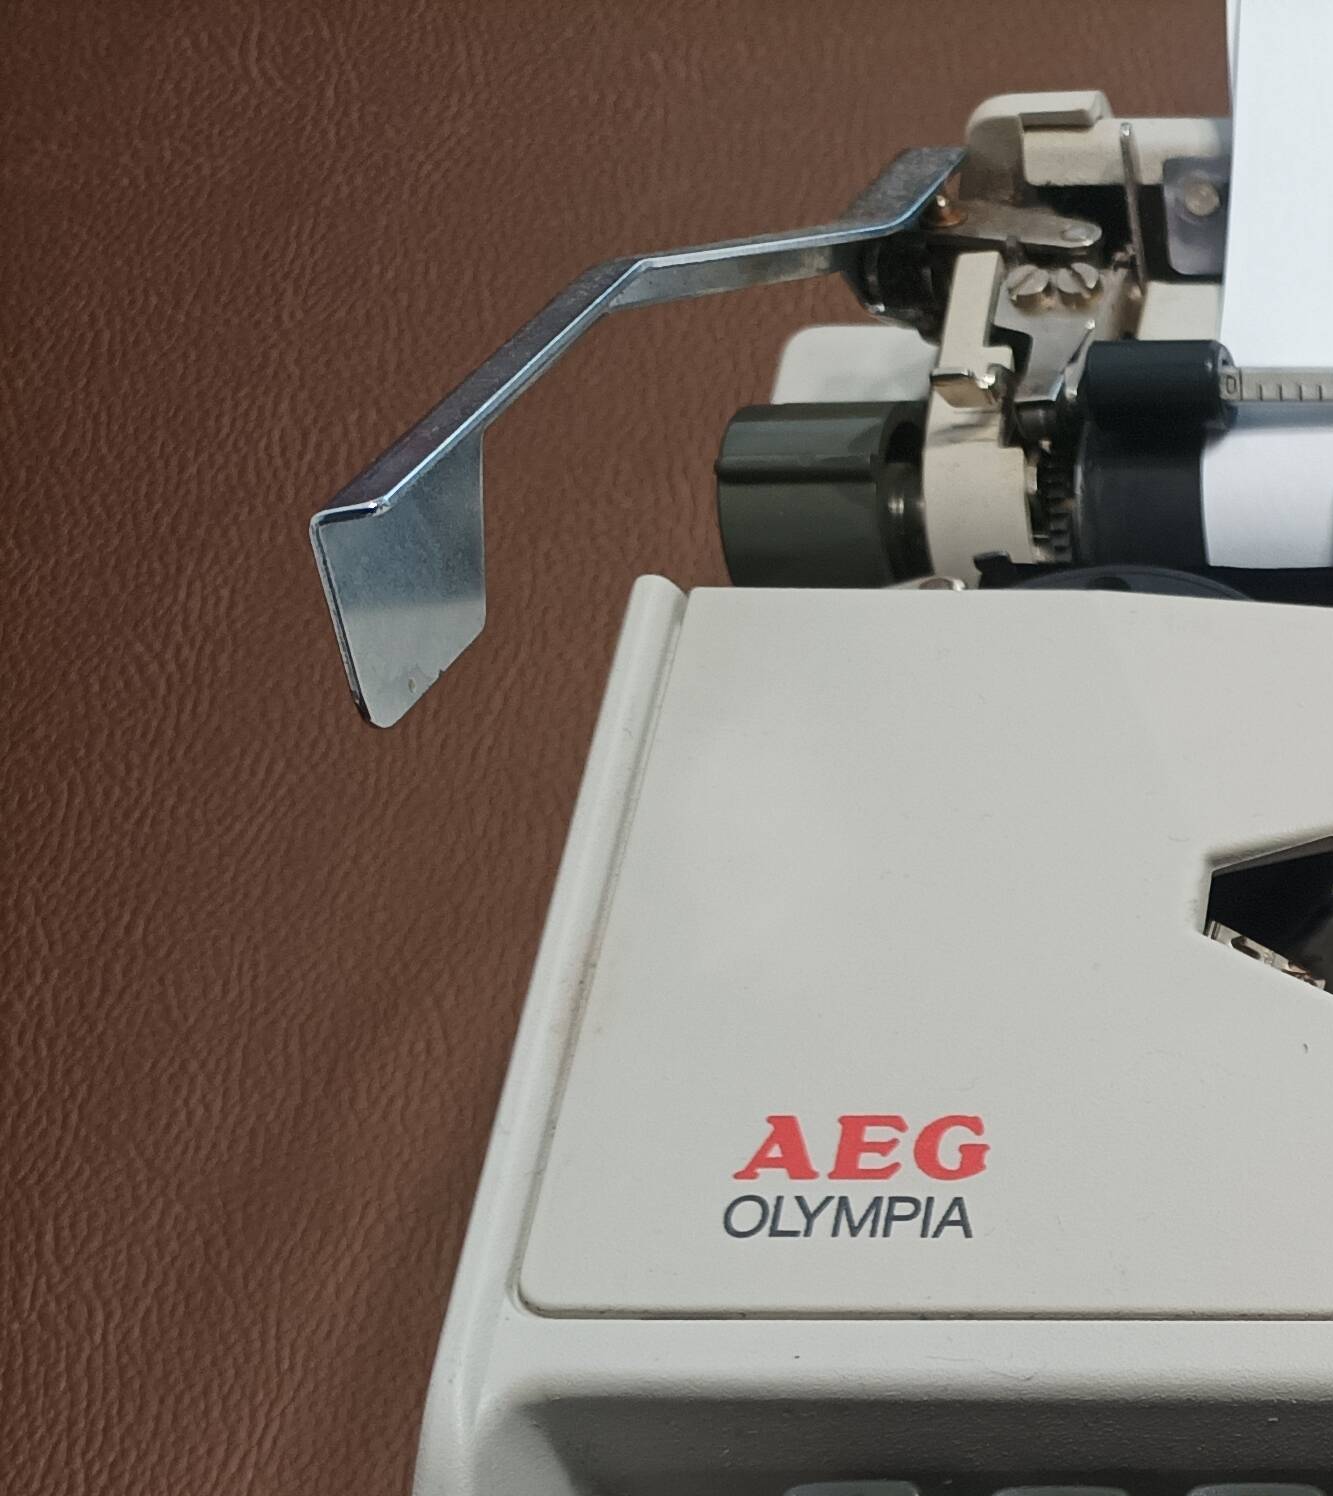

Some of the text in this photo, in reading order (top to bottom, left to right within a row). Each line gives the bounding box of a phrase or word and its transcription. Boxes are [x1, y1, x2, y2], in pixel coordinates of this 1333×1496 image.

[1225, 374, 1238, 395] 0
[732, 1114, 991, 1181] AEG
[722, 1194, 973, 1239] OLYMPIA
